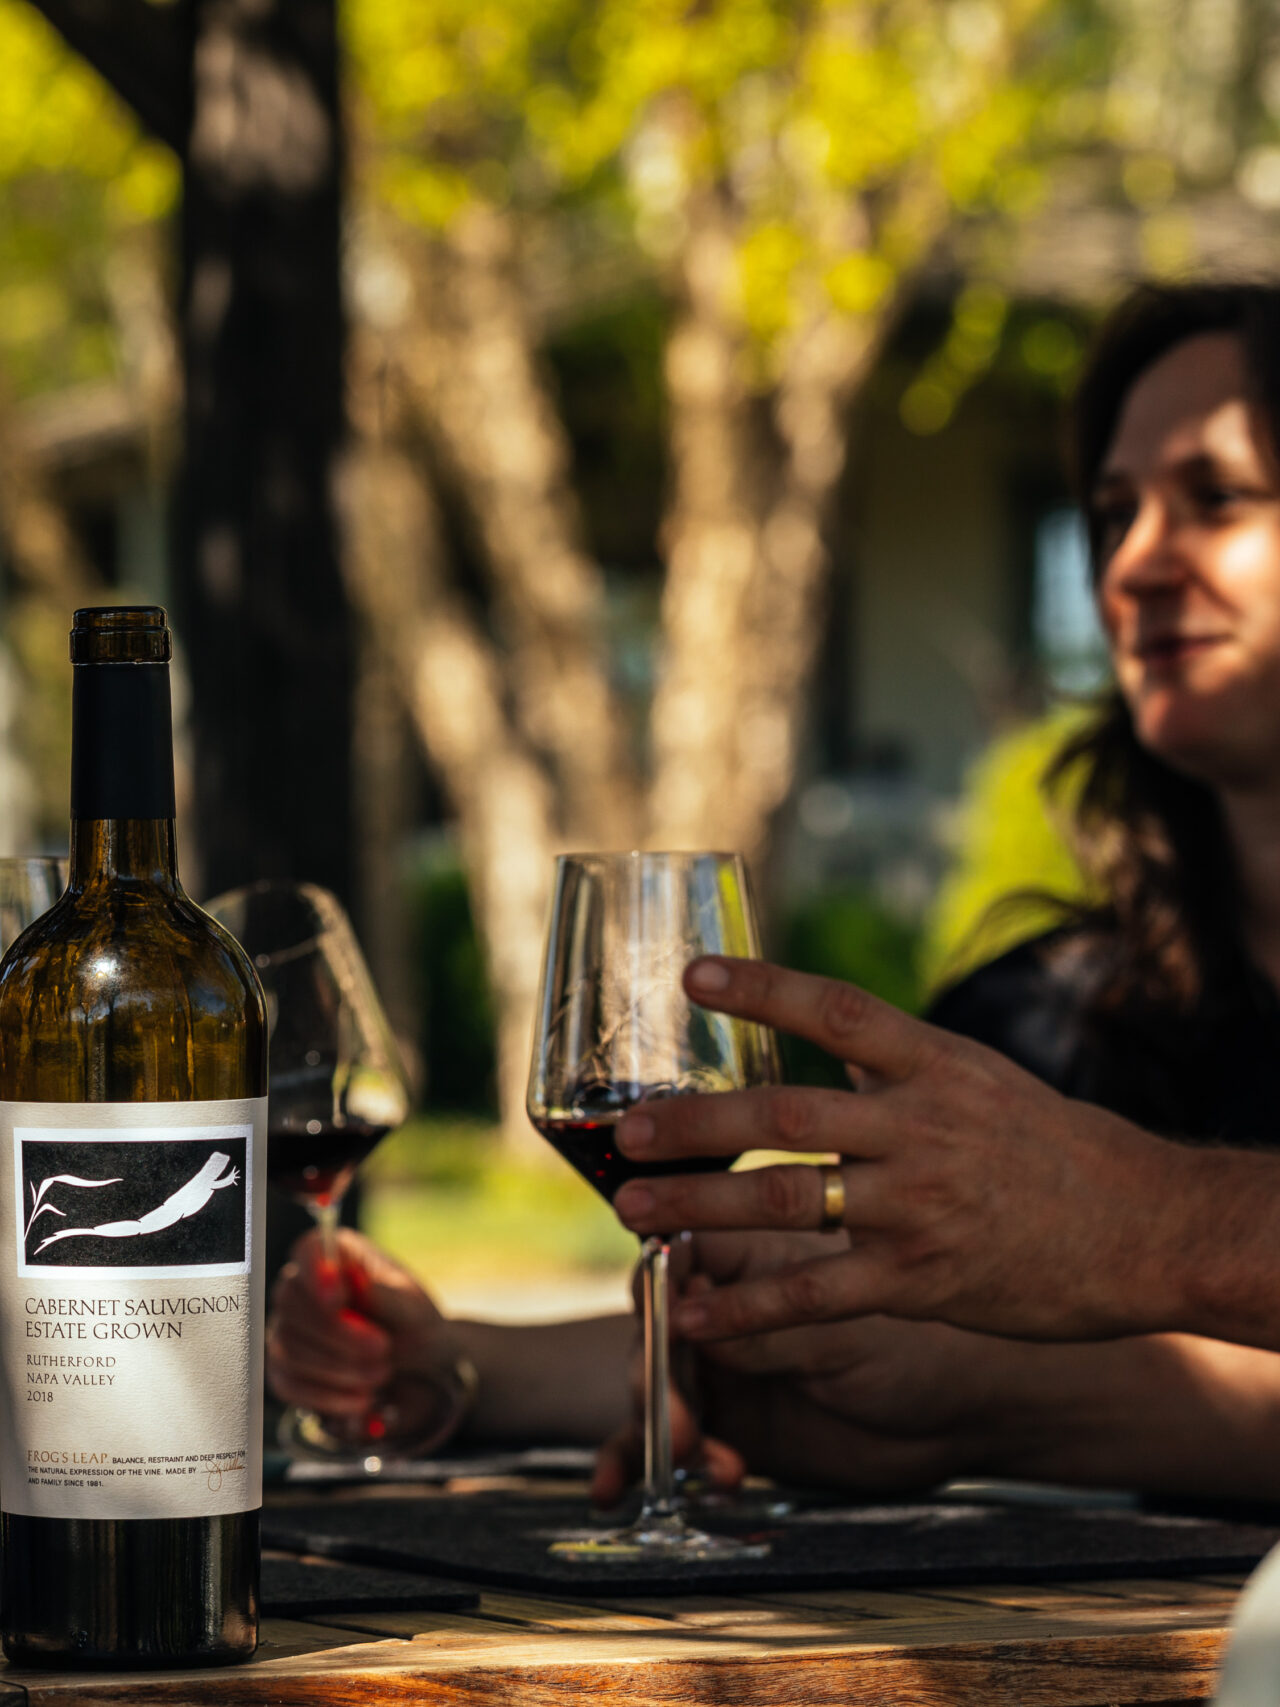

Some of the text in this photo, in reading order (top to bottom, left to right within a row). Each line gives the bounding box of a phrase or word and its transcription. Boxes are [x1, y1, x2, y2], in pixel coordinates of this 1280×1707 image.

[25, 1295, 241, 1316] CABERNET SAUVIGNON
[25, 1321, 183, 1340] ESTATE GROWN
[26, 1354, 117, 1368] RUTHERFORD
[26, 1373, 116, 1386] NAPA VALLEY
[26, 1390, 54, 1403] 2018
[27, 1450, 69, 1464] FROG'S
[112, 1456, 146, 1464] BALANCE,
[148, 1455, 184, 1464] RESTRAINT
[185, 1454, 199, 1462] AND
[200, 1453, 215, 1461] DEEP
[215, 1451, 238, 1460] RESPECT
[28, 1466, 38, 1474] THE
[39, 1466, 67, 1475] NATURAL
[69, 1468, 114, 1476] EXPRESSION
[116, 1468, 127, 1476] OF
[128, 1468, 142, 1476] THE
[165, 1467, 187, 1475] MADE
[28, 1477, 40, 1485] AND
[40, 1478, 62, 1486] FAMILY
[63, 1479, 84, 1487] SINCE
